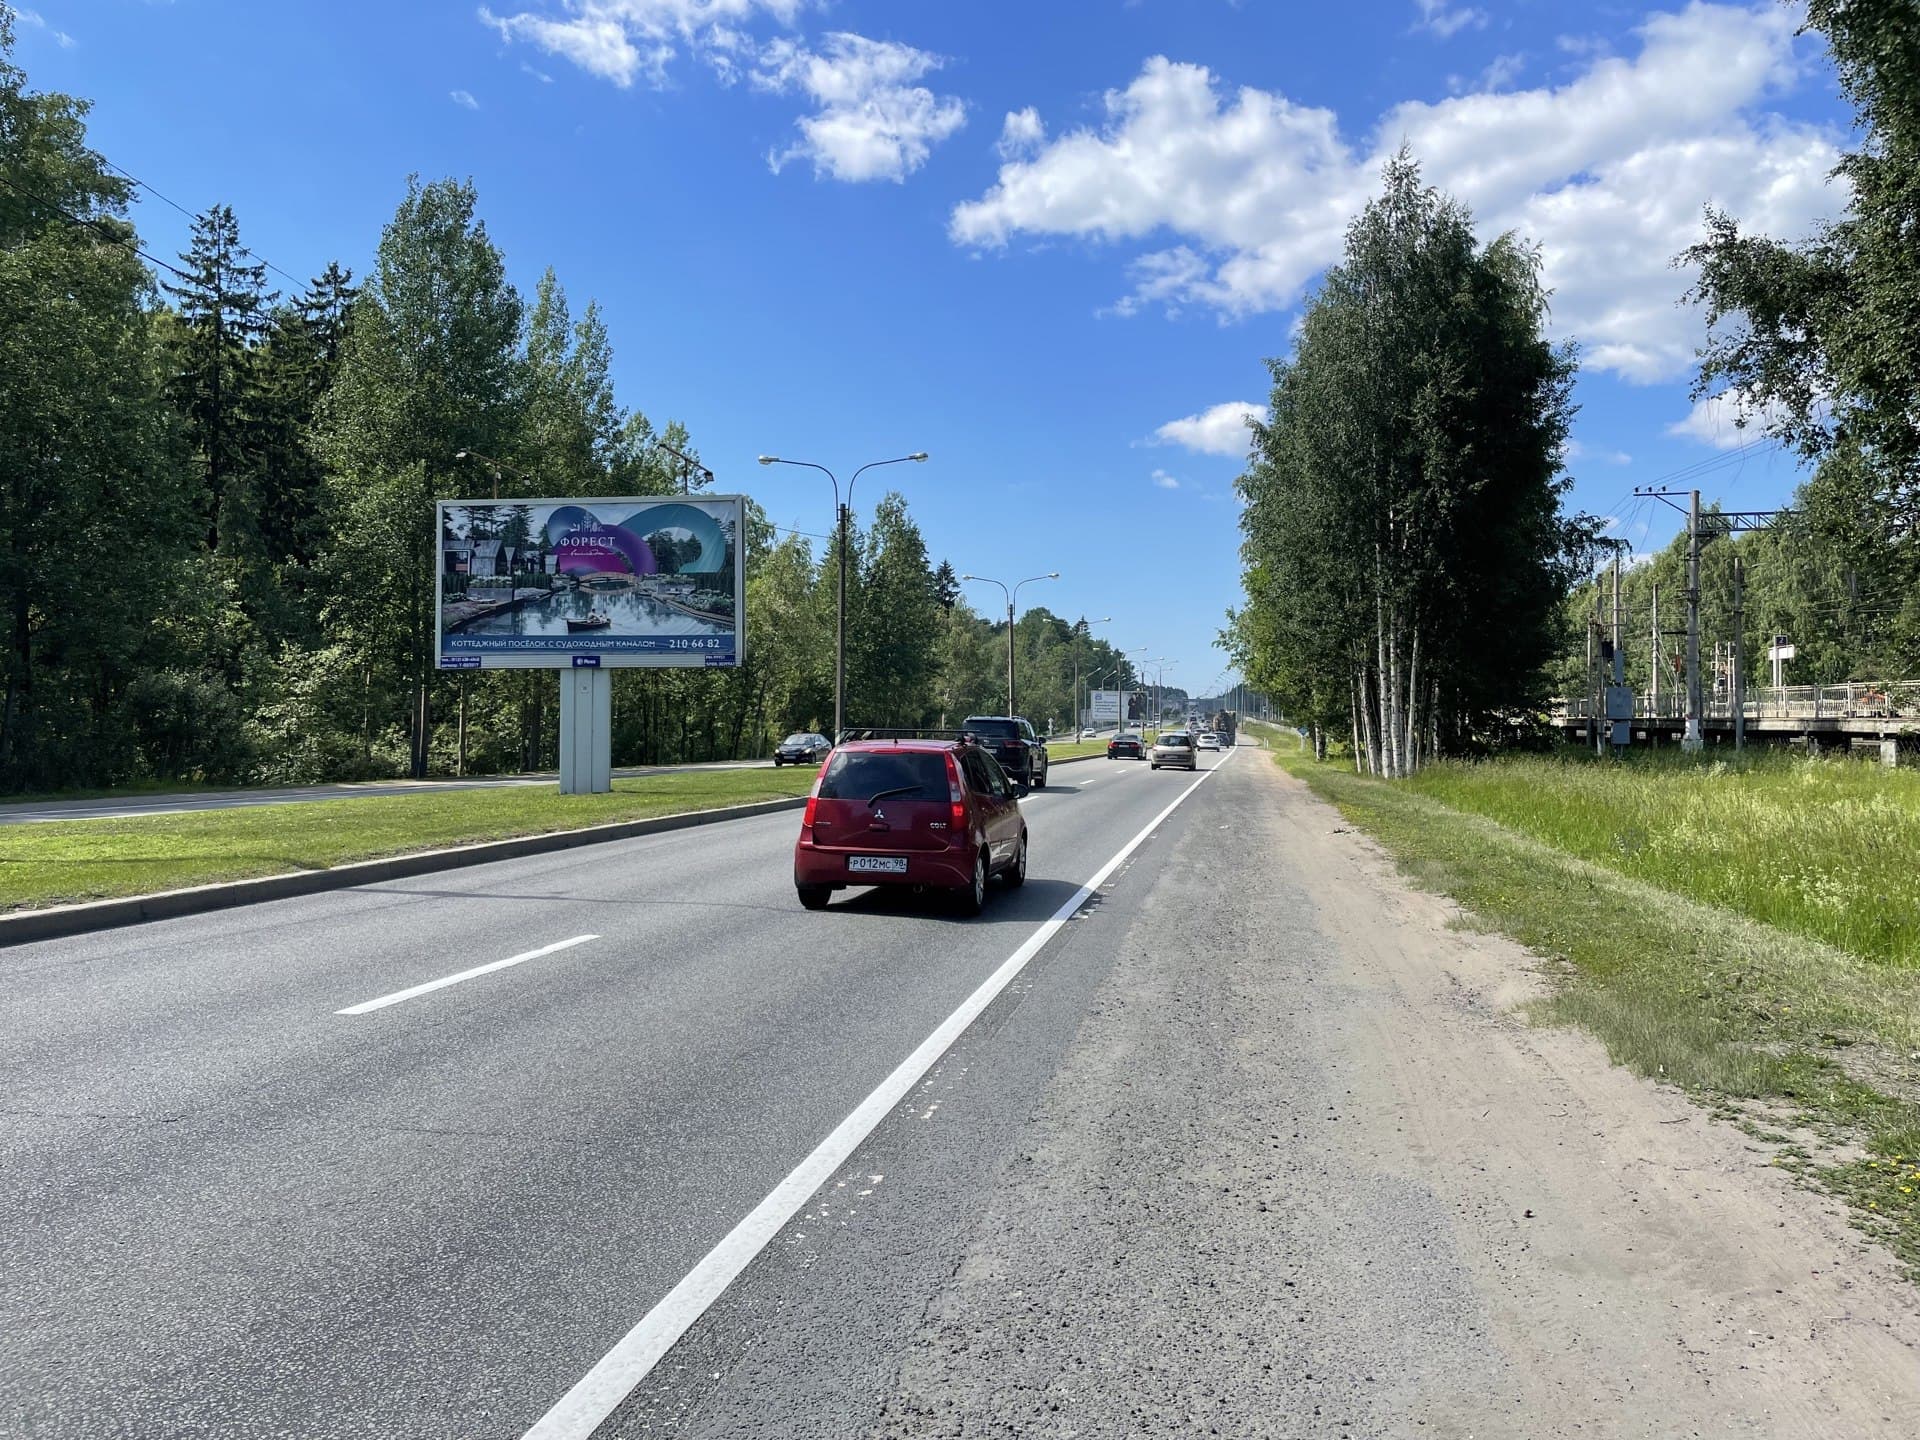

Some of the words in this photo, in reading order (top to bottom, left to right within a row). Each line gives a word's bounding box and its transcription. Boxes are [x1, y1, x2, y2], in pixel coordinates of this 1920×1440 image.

[560, 536, 616, 547] ФОРЕСТ
[451, 639, 506, 648] КОТТЕДЖНЫЙ
[548, 640, 555, 648] С
[555, 640, 614, 649] СУДОХОДНЫМ
[616, 640, 656, 648] КАНАЛОМ
[669, 639, 688, 648] 210
[691, 639, 704, 648] 66
[707, 639, 720, 648] 82
